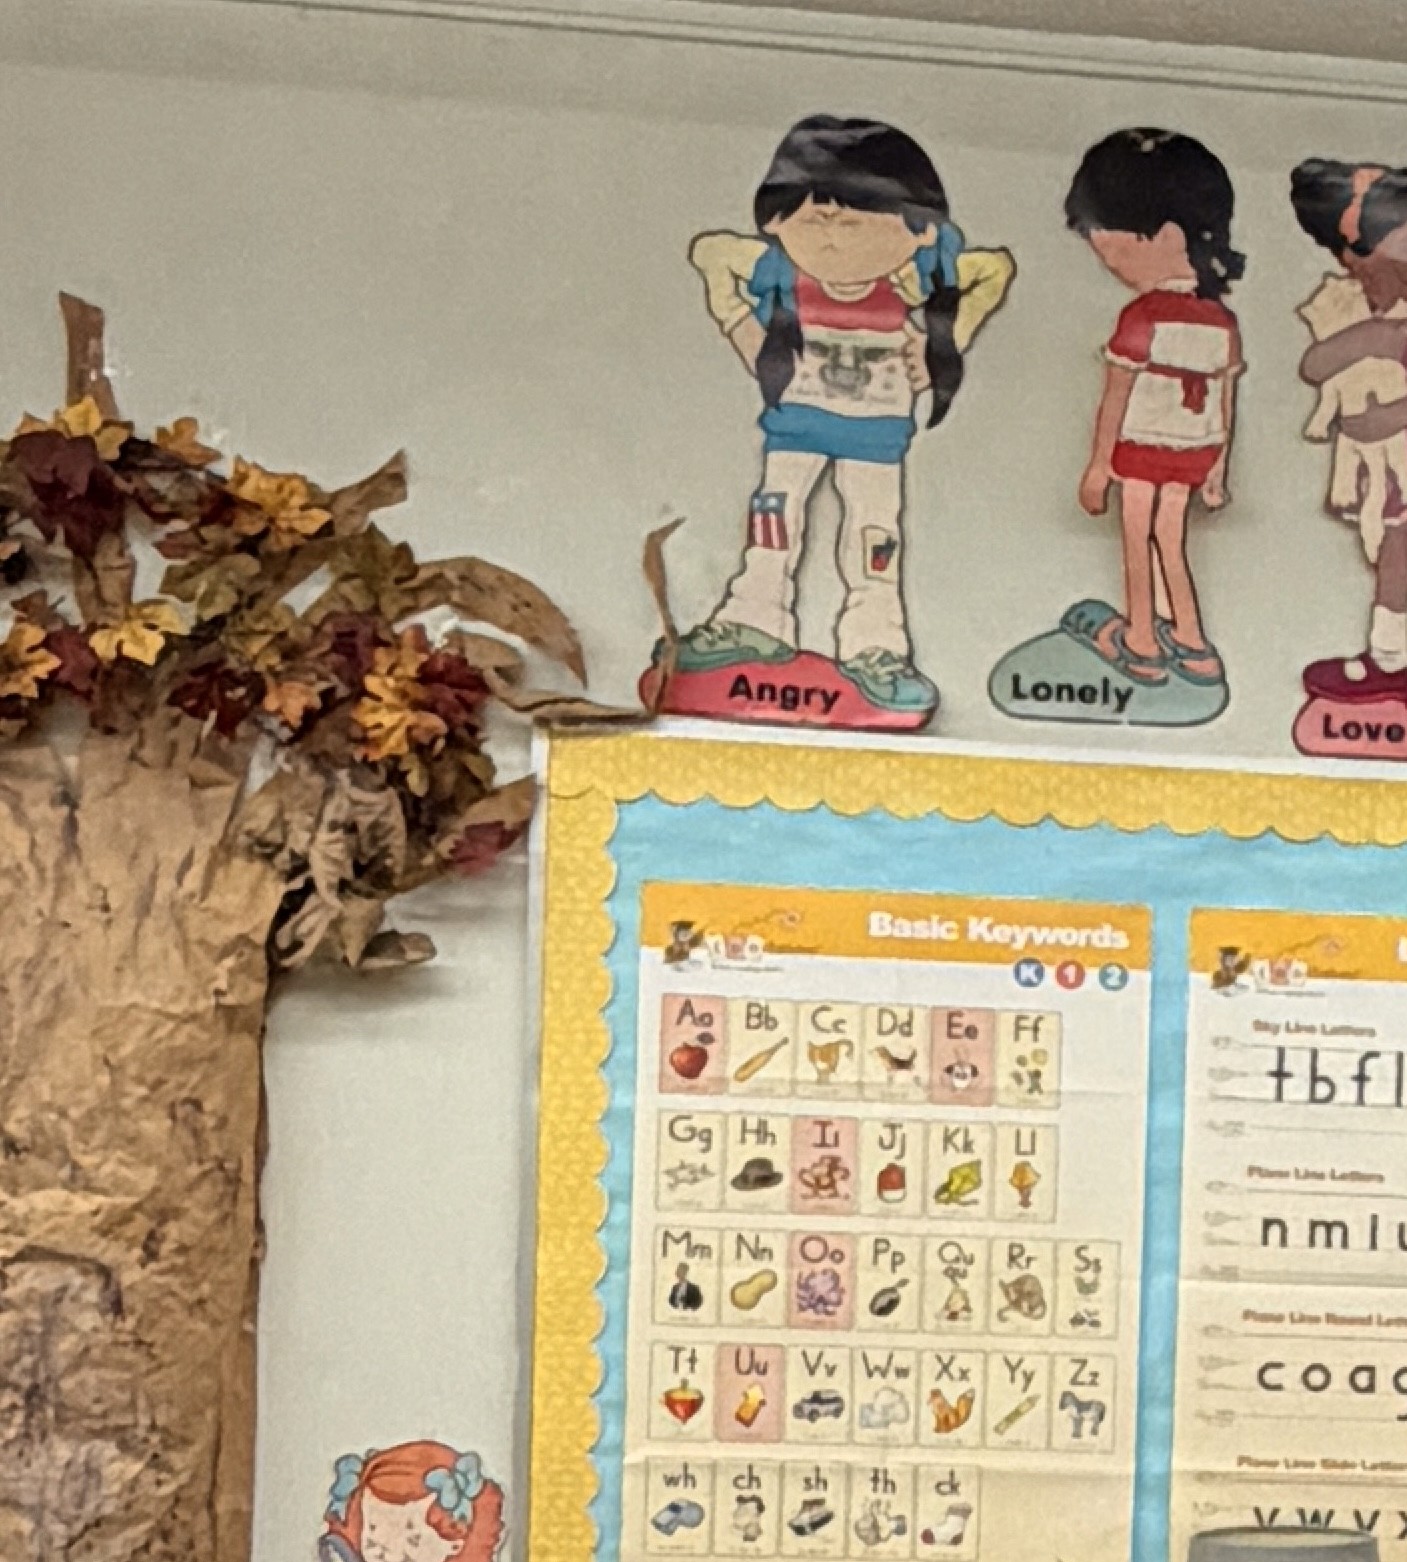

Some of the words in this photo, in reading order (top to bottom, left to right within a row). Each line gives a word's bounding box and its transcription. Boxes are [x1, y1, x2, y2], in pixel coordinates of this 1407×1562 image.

[727, 672, 841, 716] Angry
[1010, 673, 1134, 714] Lonely
[1321, 714, 1407, 745] Love
[868, 911, 959, 941] Basic
[967, 915, 1130, 951] Keywords
[1018, 964, 1039, 984] K
[1104, 966, 1123, 988] 2
[677, 1000, 714, 1027] Aa
[745, 1003, 779, 1031] Bb
[811, 1006, 848, 1034] Cc
[876, 1008, 914, 1038] Dd
[947, 1013, 980, 1040] Ee
[1013, 1015, 1043, 1042] Ff
[668, 1116, 712, 1153] Gg
[740, 1118, 777, 1146] Hh
[878, 1123, 907, 1158] Jj
[942, 1127, 976, 1155] Kk
[661, 1230, 712, 1261] Mm
[735, 1233, 774, 1262] Nn
[800, 1235, 844, 1265] Oo
[872, 1238, 906, 1274] Pp
[1007, 1244, 1037, 1269] Rr
[1074, 1245, 1102, 1273] Ss
[669, 1347, 700, 1374] Tt
[734, 1348, 768, 1377] Uu
[802, 1350, 838, 1379] Vv
[861, 1352, 911, 1380] Ww
[935, 1354, 972, 1383] Xx
[1002, 1357, 1036, 1393] Yy
[1068, 1359, 1101, 1387] Zz
[663, 1463, 697, 1490] wh
[732, 1465, 761, 1491] ch
[802, 1466, 828, 1492] sh
[868, 1467, 896, 1494] th
